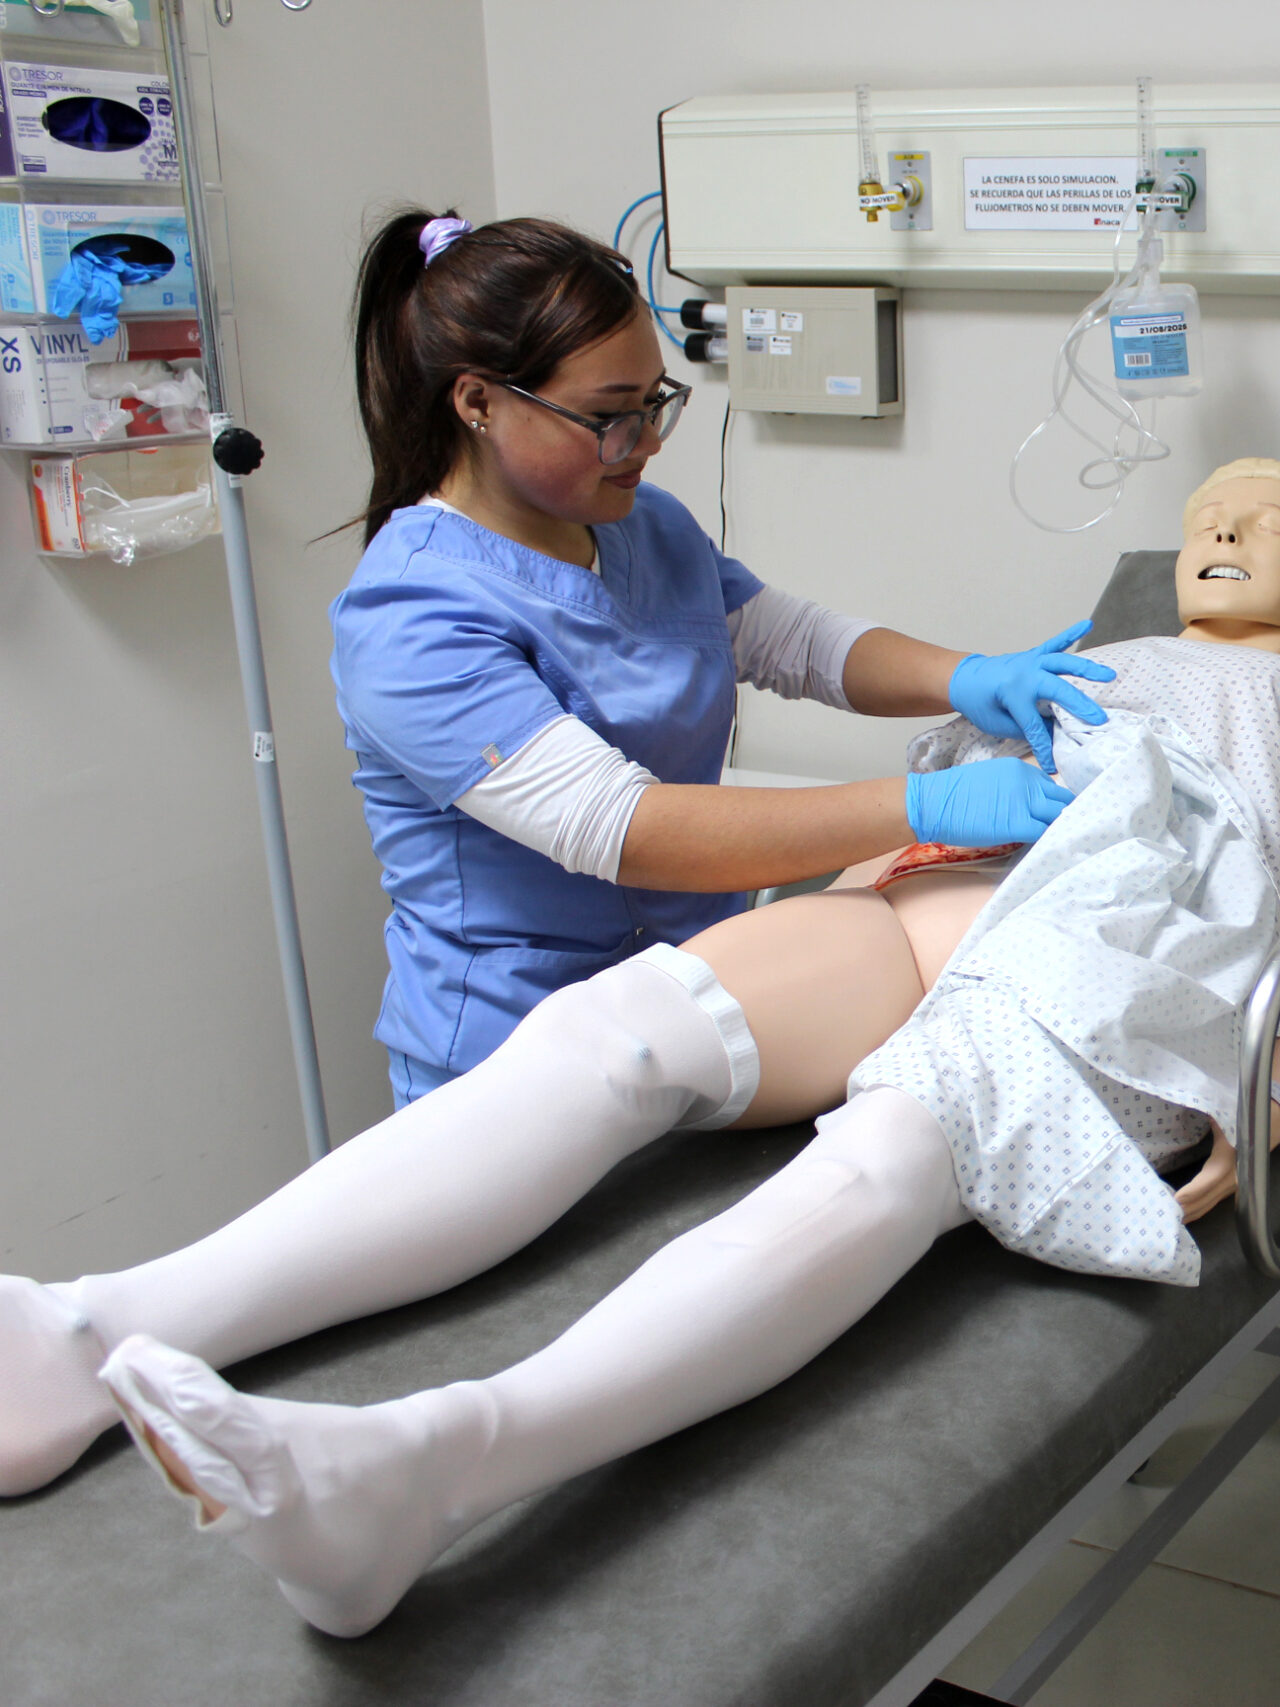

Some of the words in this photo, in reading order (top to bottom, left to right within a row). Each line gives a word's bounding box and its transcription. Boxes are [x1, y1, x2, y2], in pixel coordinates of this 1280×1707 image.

[22, 69, 64, 81] TRESOR
[163, 144, 177, 159] M
[982, 176, 992, 184] LA
[993, 176, 1025, 184] CENEFA
[1027, 176, 1036, 184] ES
[1038, 176, 1060, 184] SOLO
[872, 195, 895, 203] MOVER
[970, 190, 980, 198] SE
[982, 190, 1024, 198] RECUERDA
[1026, 190, 1044, 199] QUE
[1046, 190, 1061, 198] LAS
[1063, 190, 1101, 198] PERILLAS
[1102, 190, 1113, 198] DE
[1115, 190, 1132, 198] LOS
[975, 204, 1034, 212] FLUJOMETROS
[1035, 204, 1049, 212] NO
[1050, 204, 1060, 212] SE
[1062, 204, 1090, 212] DEBEN
[55, 211, 97, 221] TRESOR
[30, 334, 89, 355] VINYL
[0, 336, 22, 373] XS
